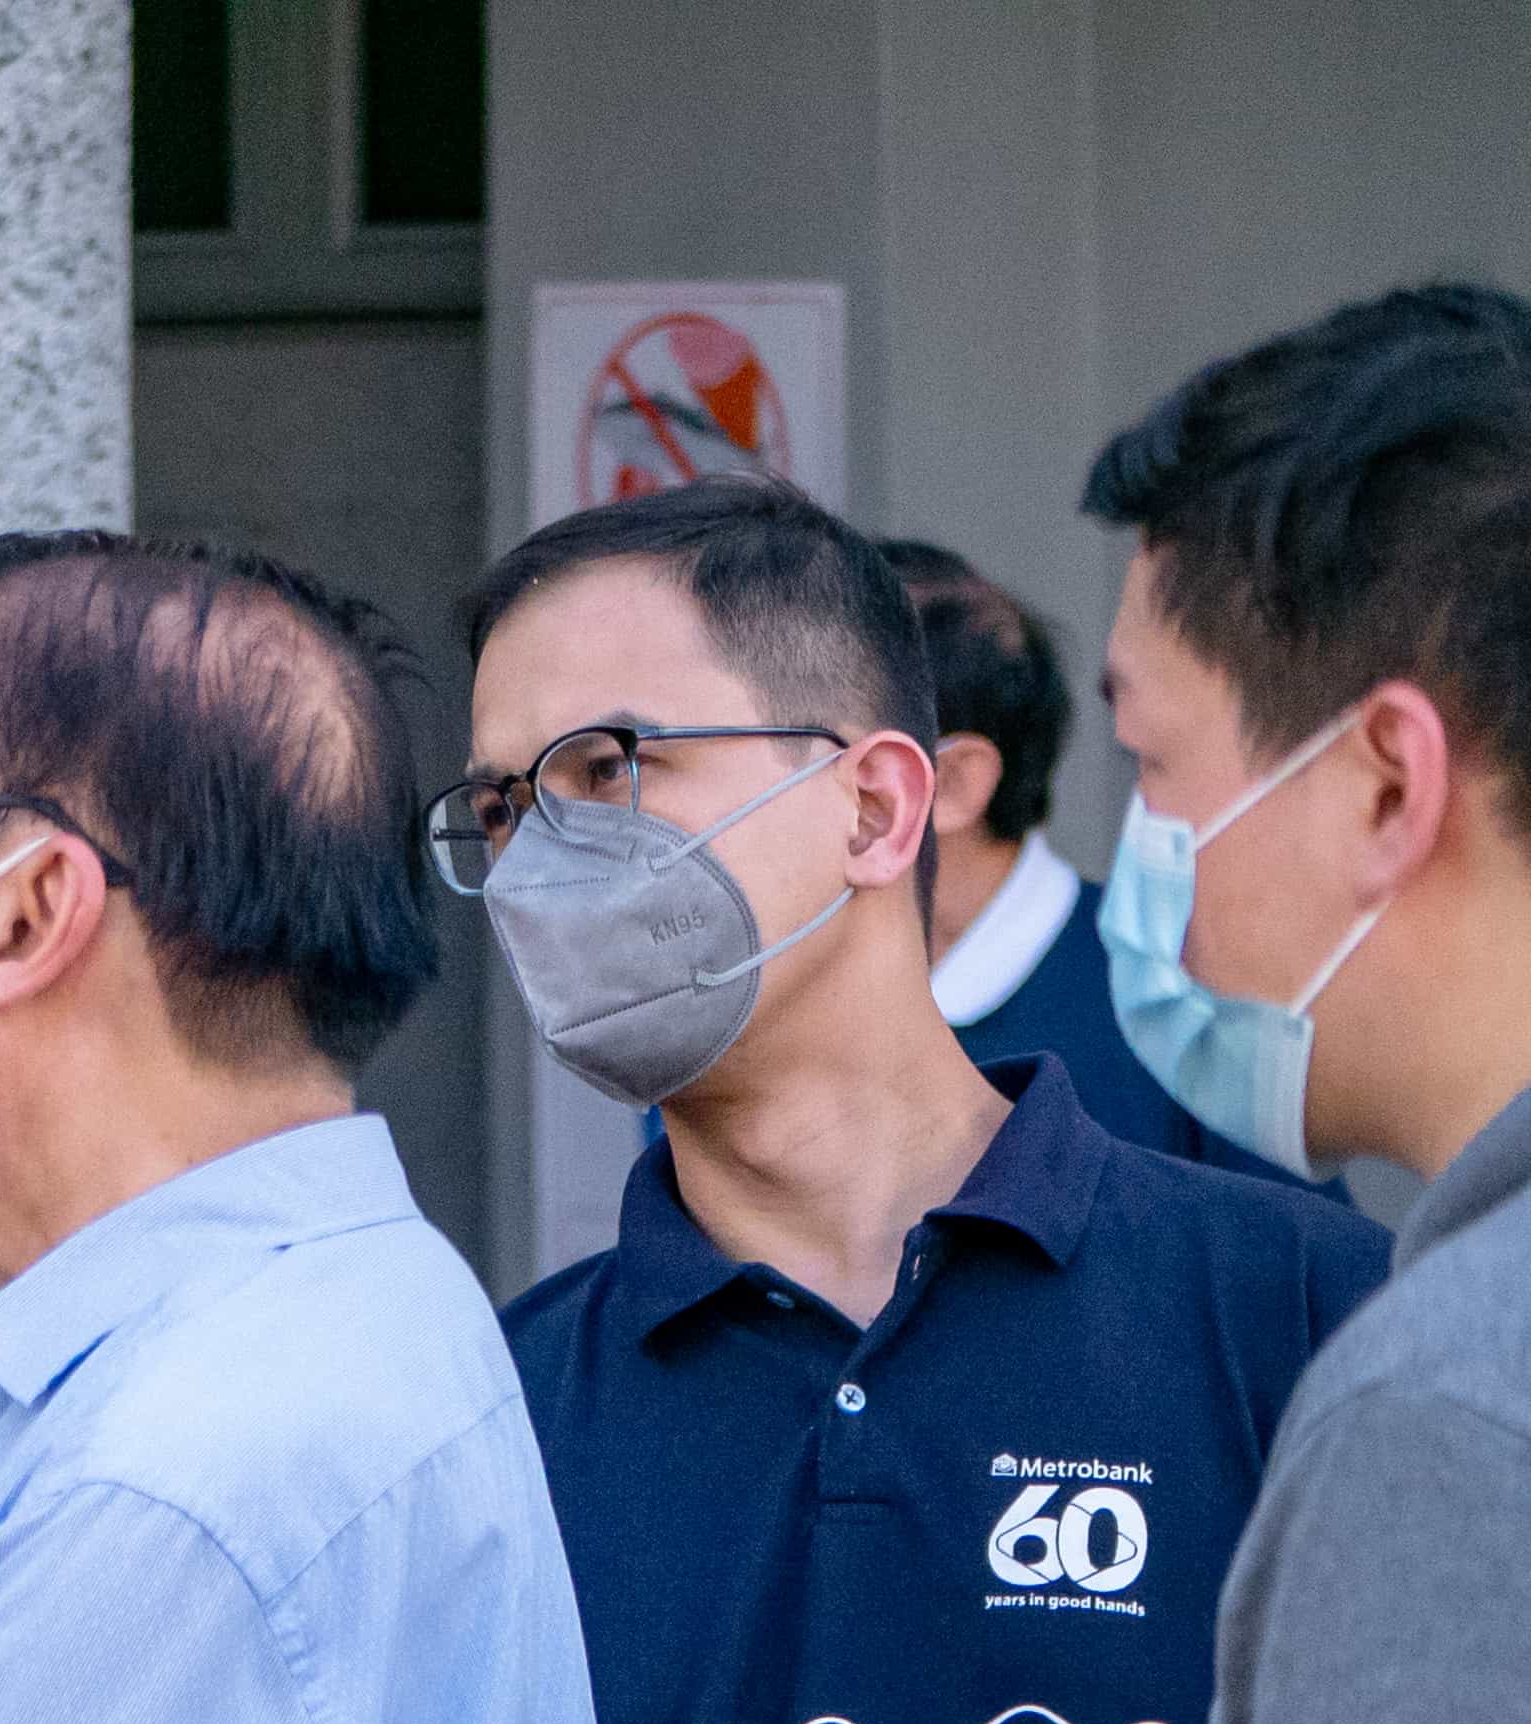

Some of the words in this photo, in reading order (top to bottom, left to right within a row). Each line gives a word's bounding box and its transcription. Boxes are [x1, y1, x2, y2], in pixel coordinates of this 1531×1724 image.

[650, 904, 706, 946] KN95
[1020, 1456, 1154, 1485] Metrobank
[987, 1484, 1149, 1593] 60
[984, 1595, 1026, 1610] years
[1029, 1593, 1044, 1607] in
[1048, 1595, 1092, 1610] good
[1094, 1598, 1146, 1617] hands
